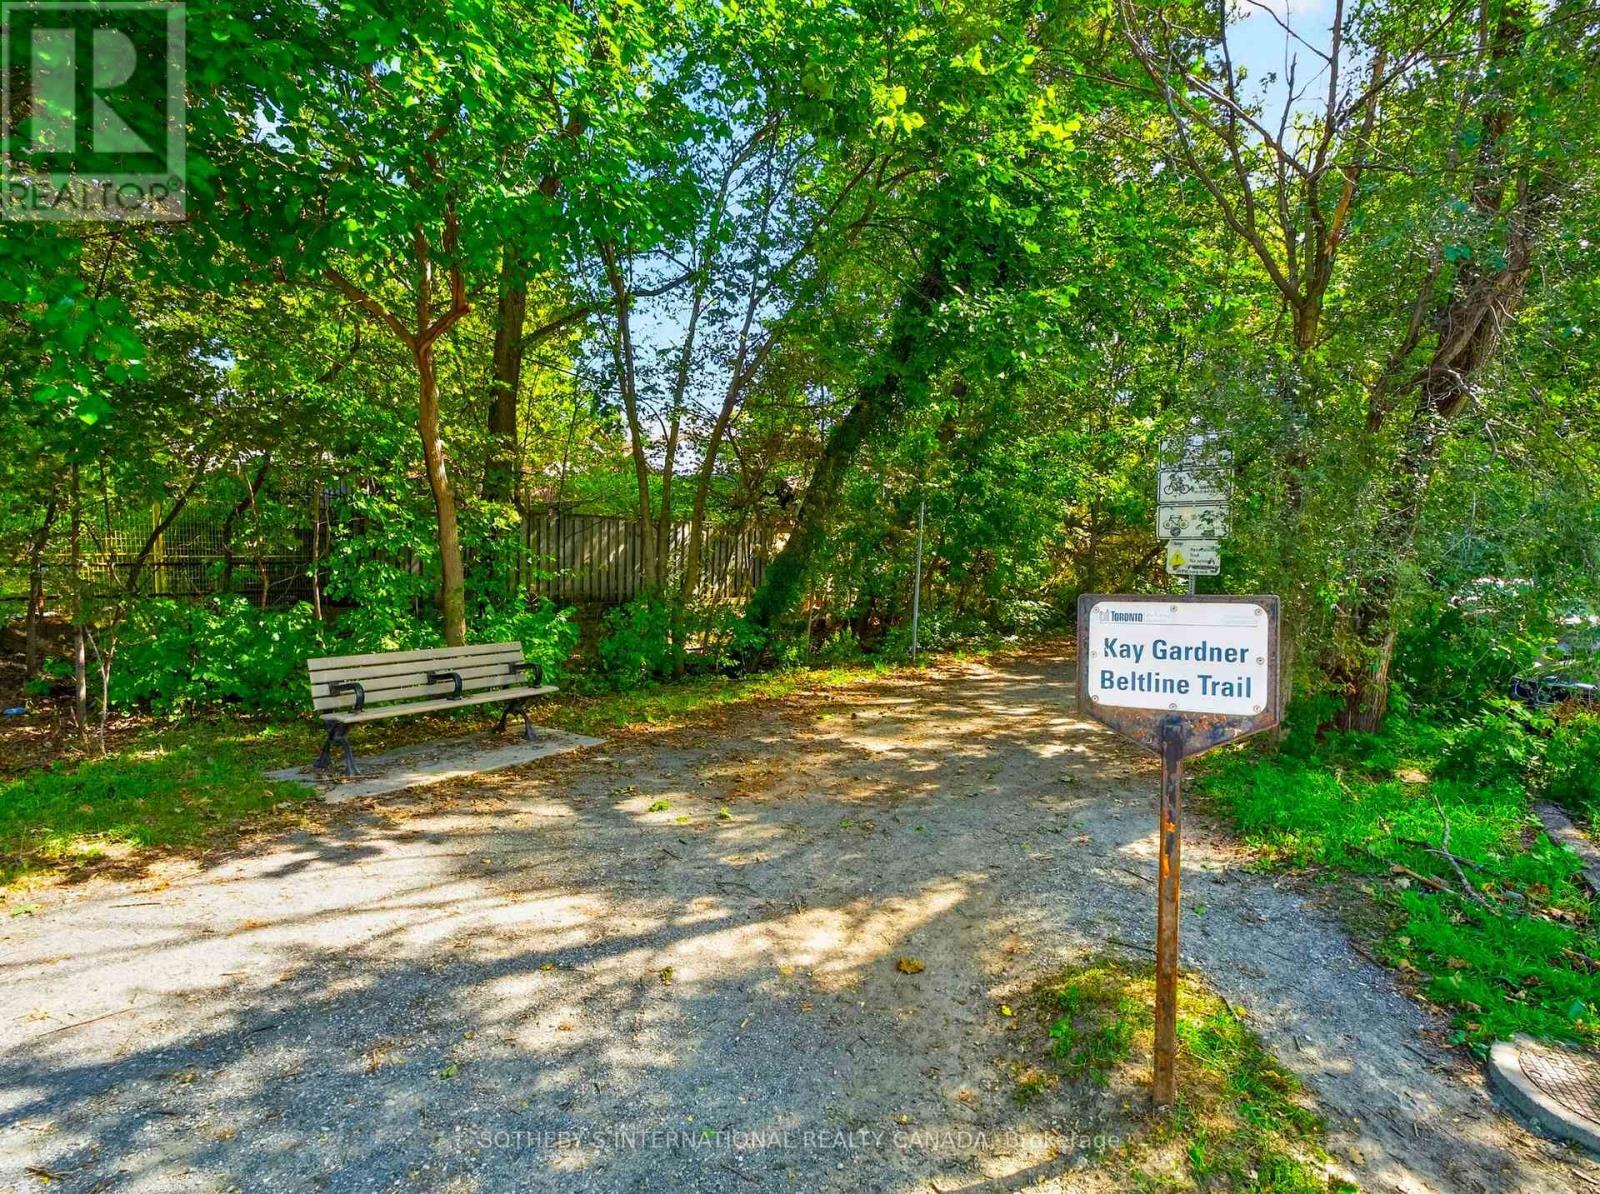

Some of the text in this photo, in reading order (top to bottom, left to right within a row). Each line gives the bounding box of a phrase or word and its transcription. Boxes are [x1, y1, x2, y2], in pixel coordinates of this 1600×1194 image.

[1111, 610, 1143, 622] TORONTO
[1104, 638, 1249, 663] Kay Gardner
[1101, 670, 1251, 698] Beltline Trail
